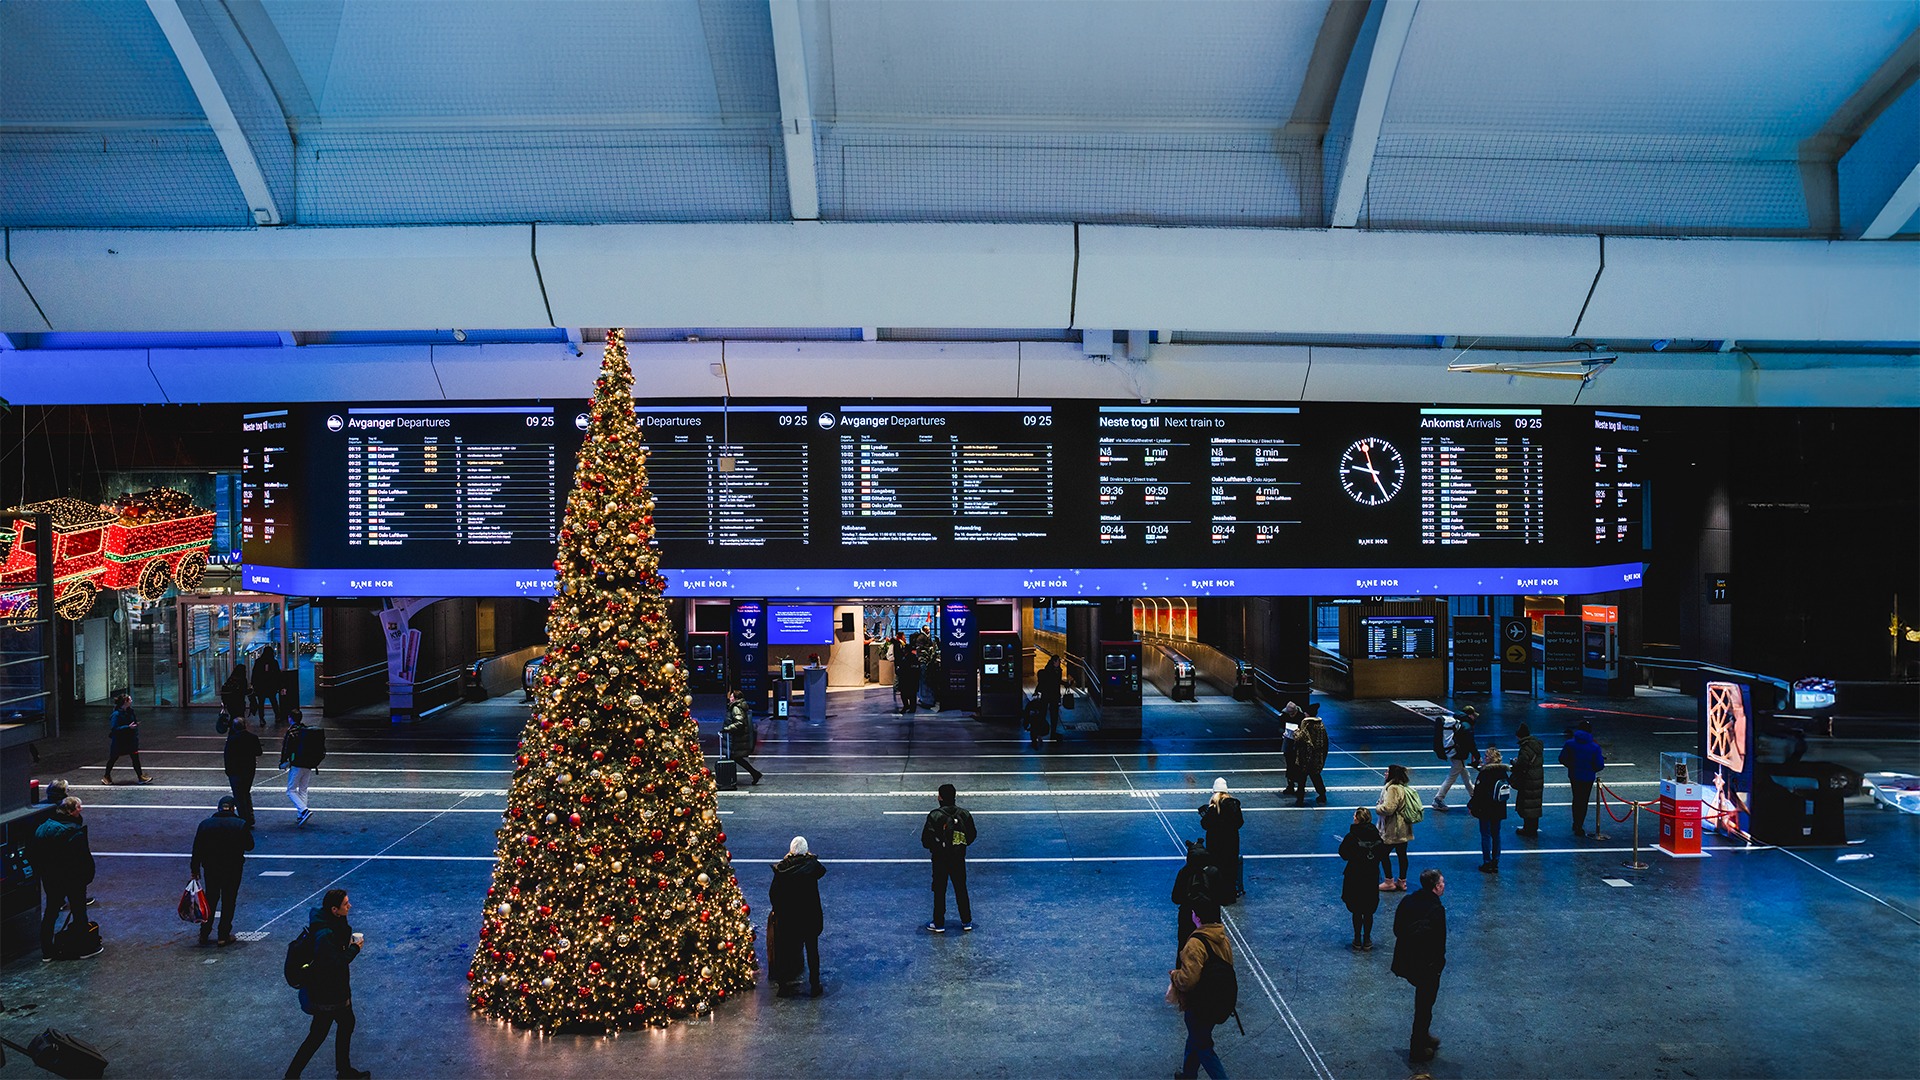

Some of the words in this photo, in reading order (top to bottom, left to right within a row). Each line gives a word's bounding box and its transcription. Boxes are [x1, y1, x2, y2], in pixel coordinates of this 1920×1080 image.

[348, 417, 394, 429] Avganger
[397, 417, 450, 429] Departures
[526, 416, 539, 427] 09
[541, 416, 554, 427] 25
[647, 415, 701, 428] Departures
[779, 415, 792, 426] 09
[795, 415, 808, 426] 25
[841, 415, 888, 428] Avganger
[891, 415, 945, 428] Departures
[1023, 415, 1037, 426] 09
[1039, 415, 1052, 426] 25
[1100, 417, 1129, 427] Neste
[1131, 417, 1148, 430] tog
[1150, 416, 1159, 427] til
[1164, 417, 1188, 427] Next
[1190, 417, 1212, 427] train
[1215, 417, 1225, 427] to
[1421, 418, 1464, 428] Ankomst
[1466, 418, 1501, 428] Arrivals
[1515, 418, 1528, 429] 09
[1530, 418, 1542, 429] 25
[1099, 447, 1112, 456] Nå
[1145, 448, 1149, 456] 1
[1152, 448, 1168, 456] min
[1211, 447, 1223, 456] Nå
[1255, 448, 1261, 456] 8
[1263, 448, 1279, 456] min
[1100, 486, 1124, 495] 09:36
[1145, 487, 1168, 495] 09:50
[1212, 486, 1224, 495] Nå
[1256, 487, 1262, 495] 4
[1264, 487, 1279, 495] min
[1100, 526, 1124, 534] 09:44
[1146, 526, 1169, 534] 10:04
[1212, 526, 1235, 534] 09:44
[1256, 526, 1280, 534] 10:14
[351, 581, 372, 589] BANE
[516, 581, 538, 589] BANE
[684, 581, 706, 589] BANE
[854, 581, 876, 589] BANE
[1024, 581, 1046, 589] BANE
[1192, 580, 1213, 589] BANE
[1357, 580, 1378, 588] BANE
[1517, 579, 1538, 587] BANE
[1714, 589, 1725, 599] 11
